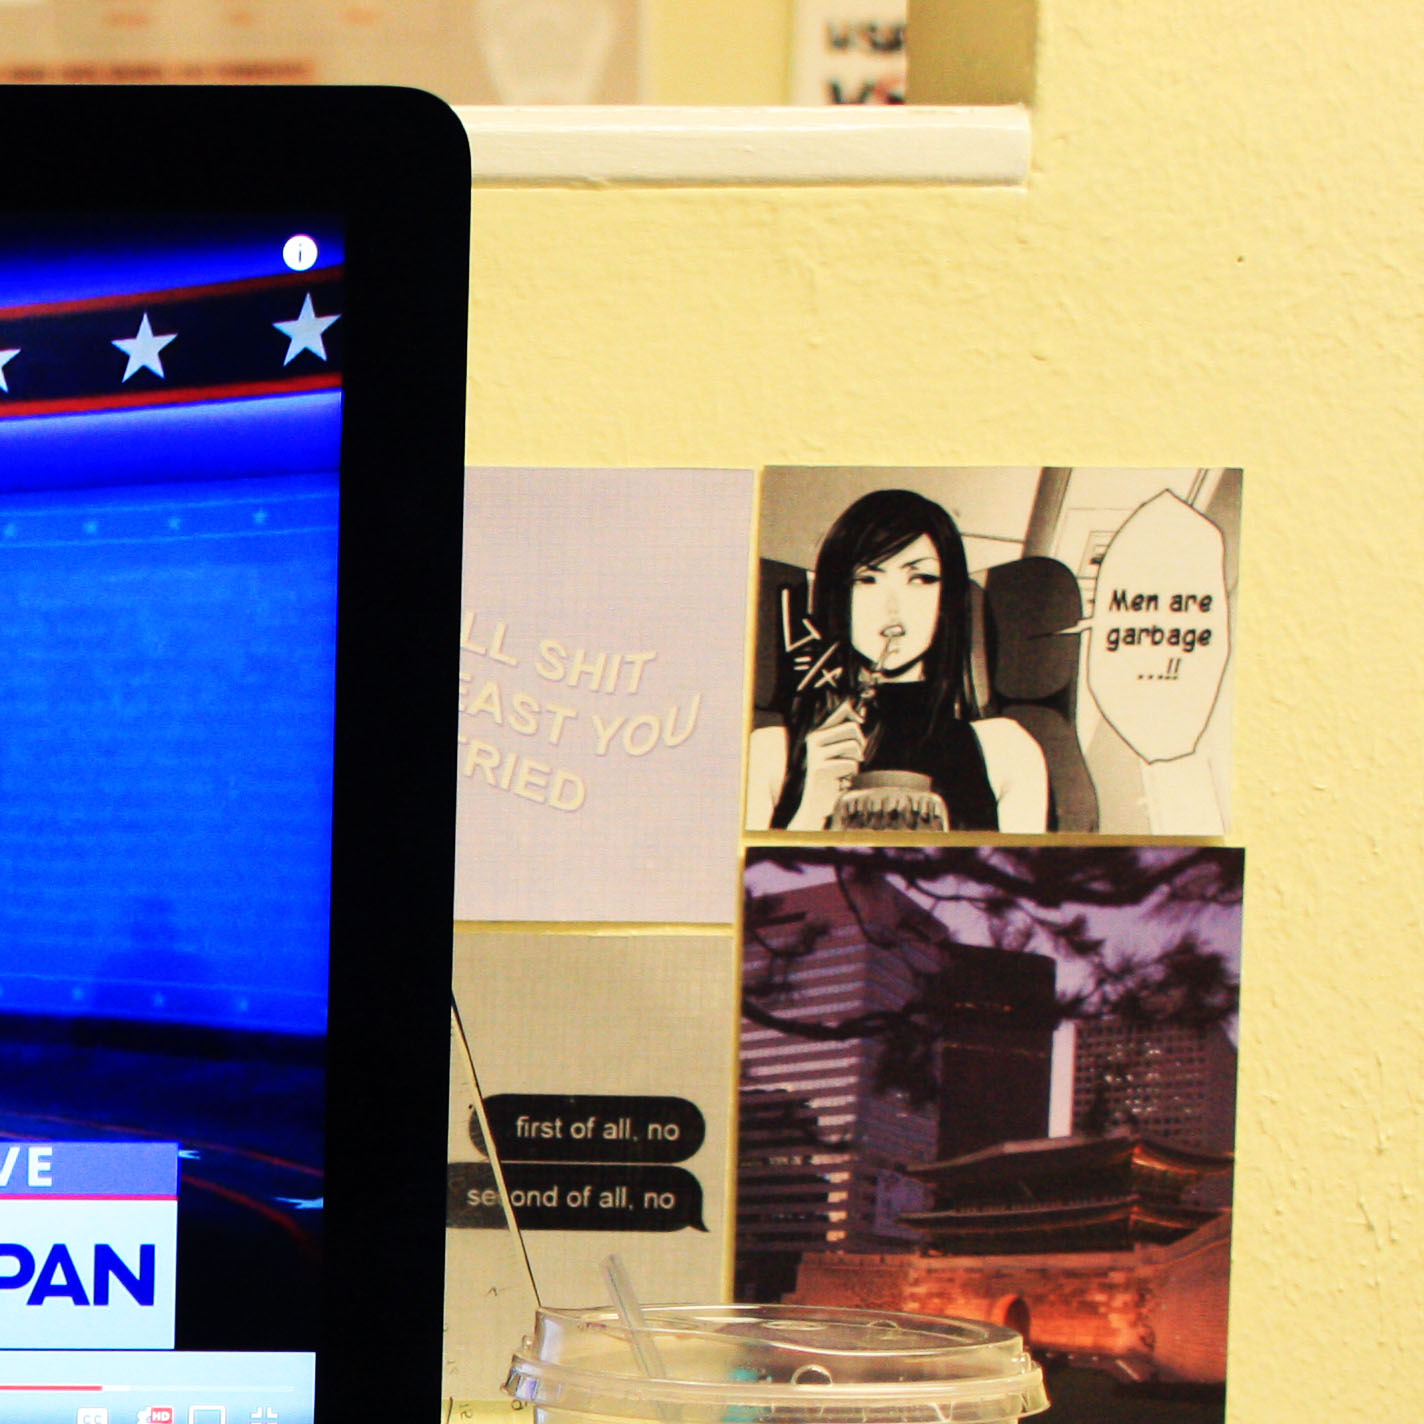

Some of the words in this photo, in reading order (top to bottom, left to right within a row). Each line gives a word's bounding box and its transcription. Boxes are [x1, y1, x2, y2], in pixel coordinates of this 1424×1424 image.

[1109, 589, 1159, 613] Men
[1170, 591, 1212, 613] are
[1106, 625, 1212, 653] garbage
[536, 637, 657, 696] SHIT
[592, 692, 703, 757] YOU
[458, 735, 586, 813] RIED
[516, 1116, 562, 1139] first
[570, 1116, 596, 1140] of
[603, 1118, 639, 1142] all,
[648, 1123, 680, 1140] no
[567, 1186, 591, 1208] of
[599, 1187, 634, 1210] all,
[644, 1193, 675, 1209] no
[152, 1410, 170, 1422] HD
